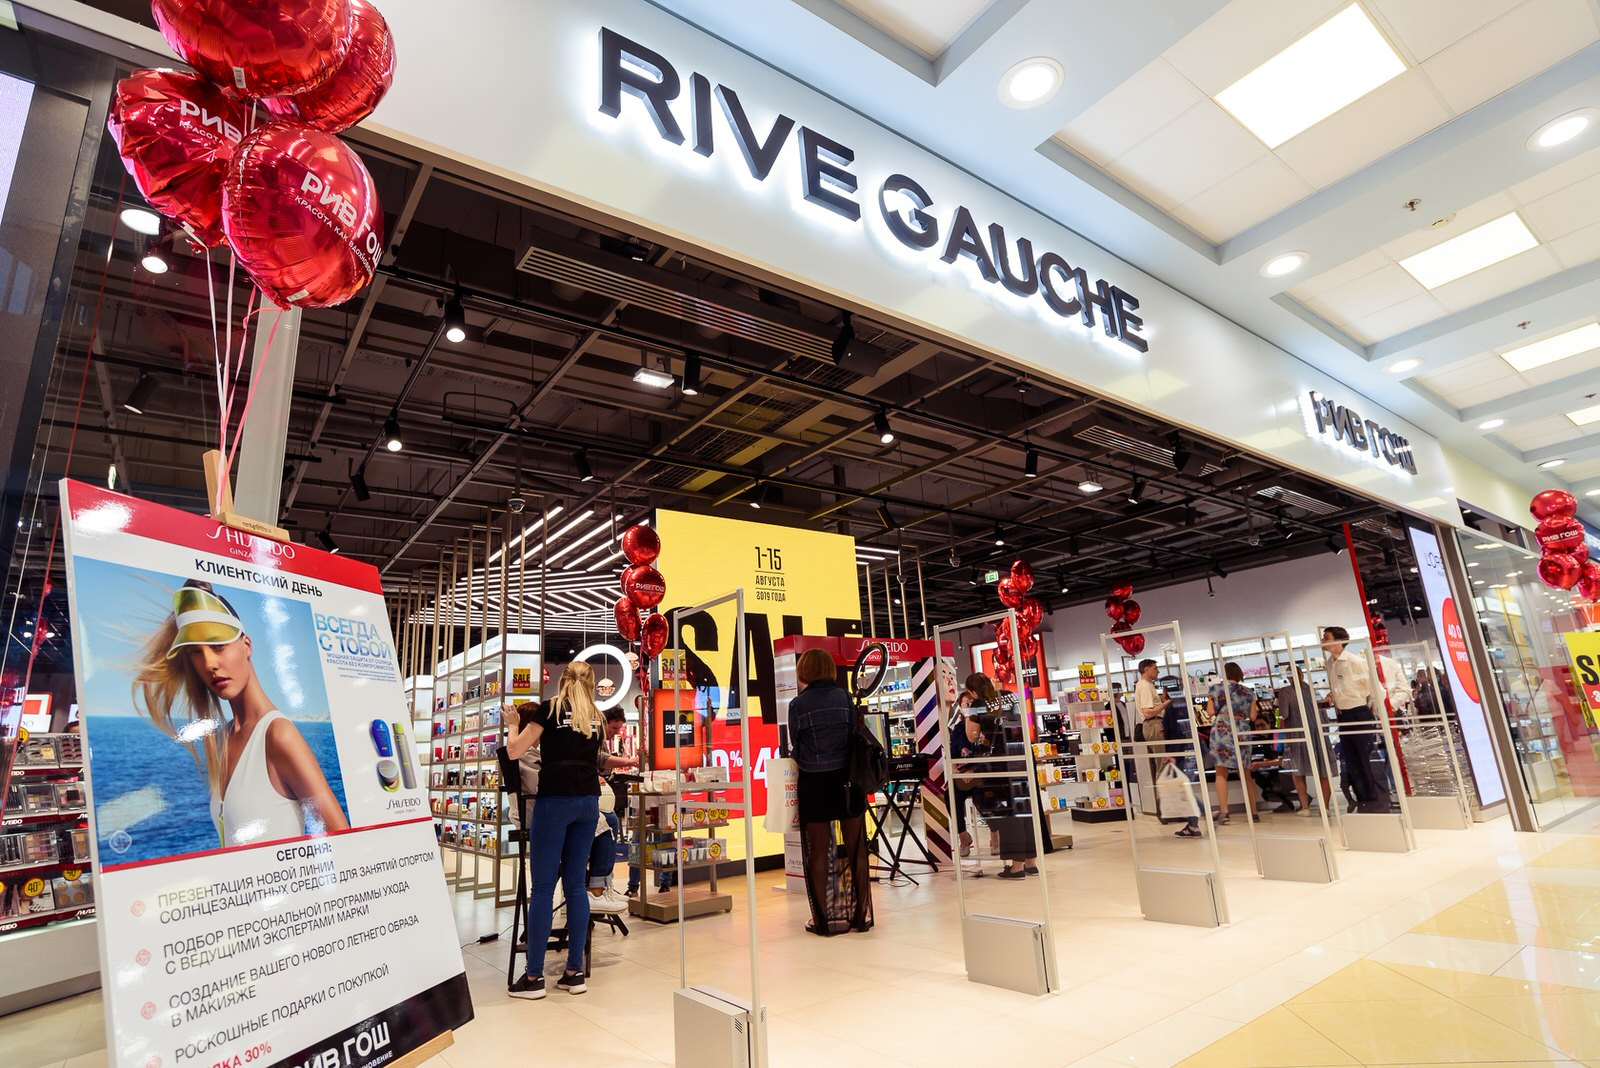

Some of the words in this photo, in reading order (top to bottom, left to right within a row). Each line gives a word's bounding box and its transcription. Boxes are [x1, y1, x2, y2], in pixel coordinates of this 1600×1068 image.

[180, 99, 242, 144] РИВ
[301, 171, 357, 227] РИВ
[598, 26, 862, 222] RIVE
[878, 173, 1149, 354] GAUCHE
[294, 195, 332, 228] КРАСОТА
[334, 226, 349, 242] КАК
[195, 558, 289, 590] КЛИЕНТСКИЙ
[291, 581, 323, 598] ДЕНЬ
[755, 546, 782, 570] 1-15
[755, 575, 785, 587] АВГУСТА
[756, 591, 771, 601] 2019
[771, 592, 787, 603] ГОДА
[314, 612, 381, 641] ВСЕГДА
[856, 639, 909, 653] SEIDO
[335, 635, 393, 660] ТОБОЙ
[662, 658, 686, 671] SAE
[663, 606, 863, 726] SA
[513, 673, 531, 682] SALE
[1194, 696, 1209, 704] CHA
[386, 797, 421, 810] SHISEIDO
[276, 842, 332, 862] СЕГОДНЯ:
[158, 876, 254, 908] ПРЕЗЕНТАЦИЯ
[256, 864, 297, 887] НОВОЙ
[299, 861, 335, 878] ЛИНИИ
[159, 884, 289, 924] СОЛНЦЕЗАЩИТНЫХ
[290, 873, 338, 893] СРЕДСТВ
[339, 868, 359, 883] ДЛЯ
[359, 857, 398, 877] ЗАНЯТИЙ
[398, 851, 435, 868] СПОРТОМ
[163, 930, 224, 958] ПОДБОР
[227, 903, 322, 940] ПЕРСОНАЛЬНОЙ
[323, 888, 382, 912] ПРОГРАММЫ
[383, 880, 411, 898] УХОДА
[165, 960, 177, 975] С
[180, 936, 260, 971] ВЕДУЩИМИ
[263, 914, 336, 945] ЭКСПЕРТАМИ
[337, 904, 370, 924] МАРКИ
[169, 972, 247, 1009] СОЗДАНИЕ
[250, 954, 300, 982] ВАШЕГО
[302, 939, 346, 964] НОВОГО
[346, 929, 387, 949] ЛЕТНЕГО
[388, 914, 420, 933] ОБРАЗА
[171, 1012, 182, 1028] В
[186, 985, 257, 1022] МАКИЯЖЕ
[175, 1013, 270, 1064] РОСКОШНЫЕ
[271, 990, 327, 1022] ПОДАРКИ
[328, 986, 336, 999] С
[338, 963, 390, 995] ПОКУПКОЙ
[244, 1040, 272, 1062] 30%
[292, 1047, 341, 1068] ИВ
[343, 1021, 391, 1065] ГОШ
